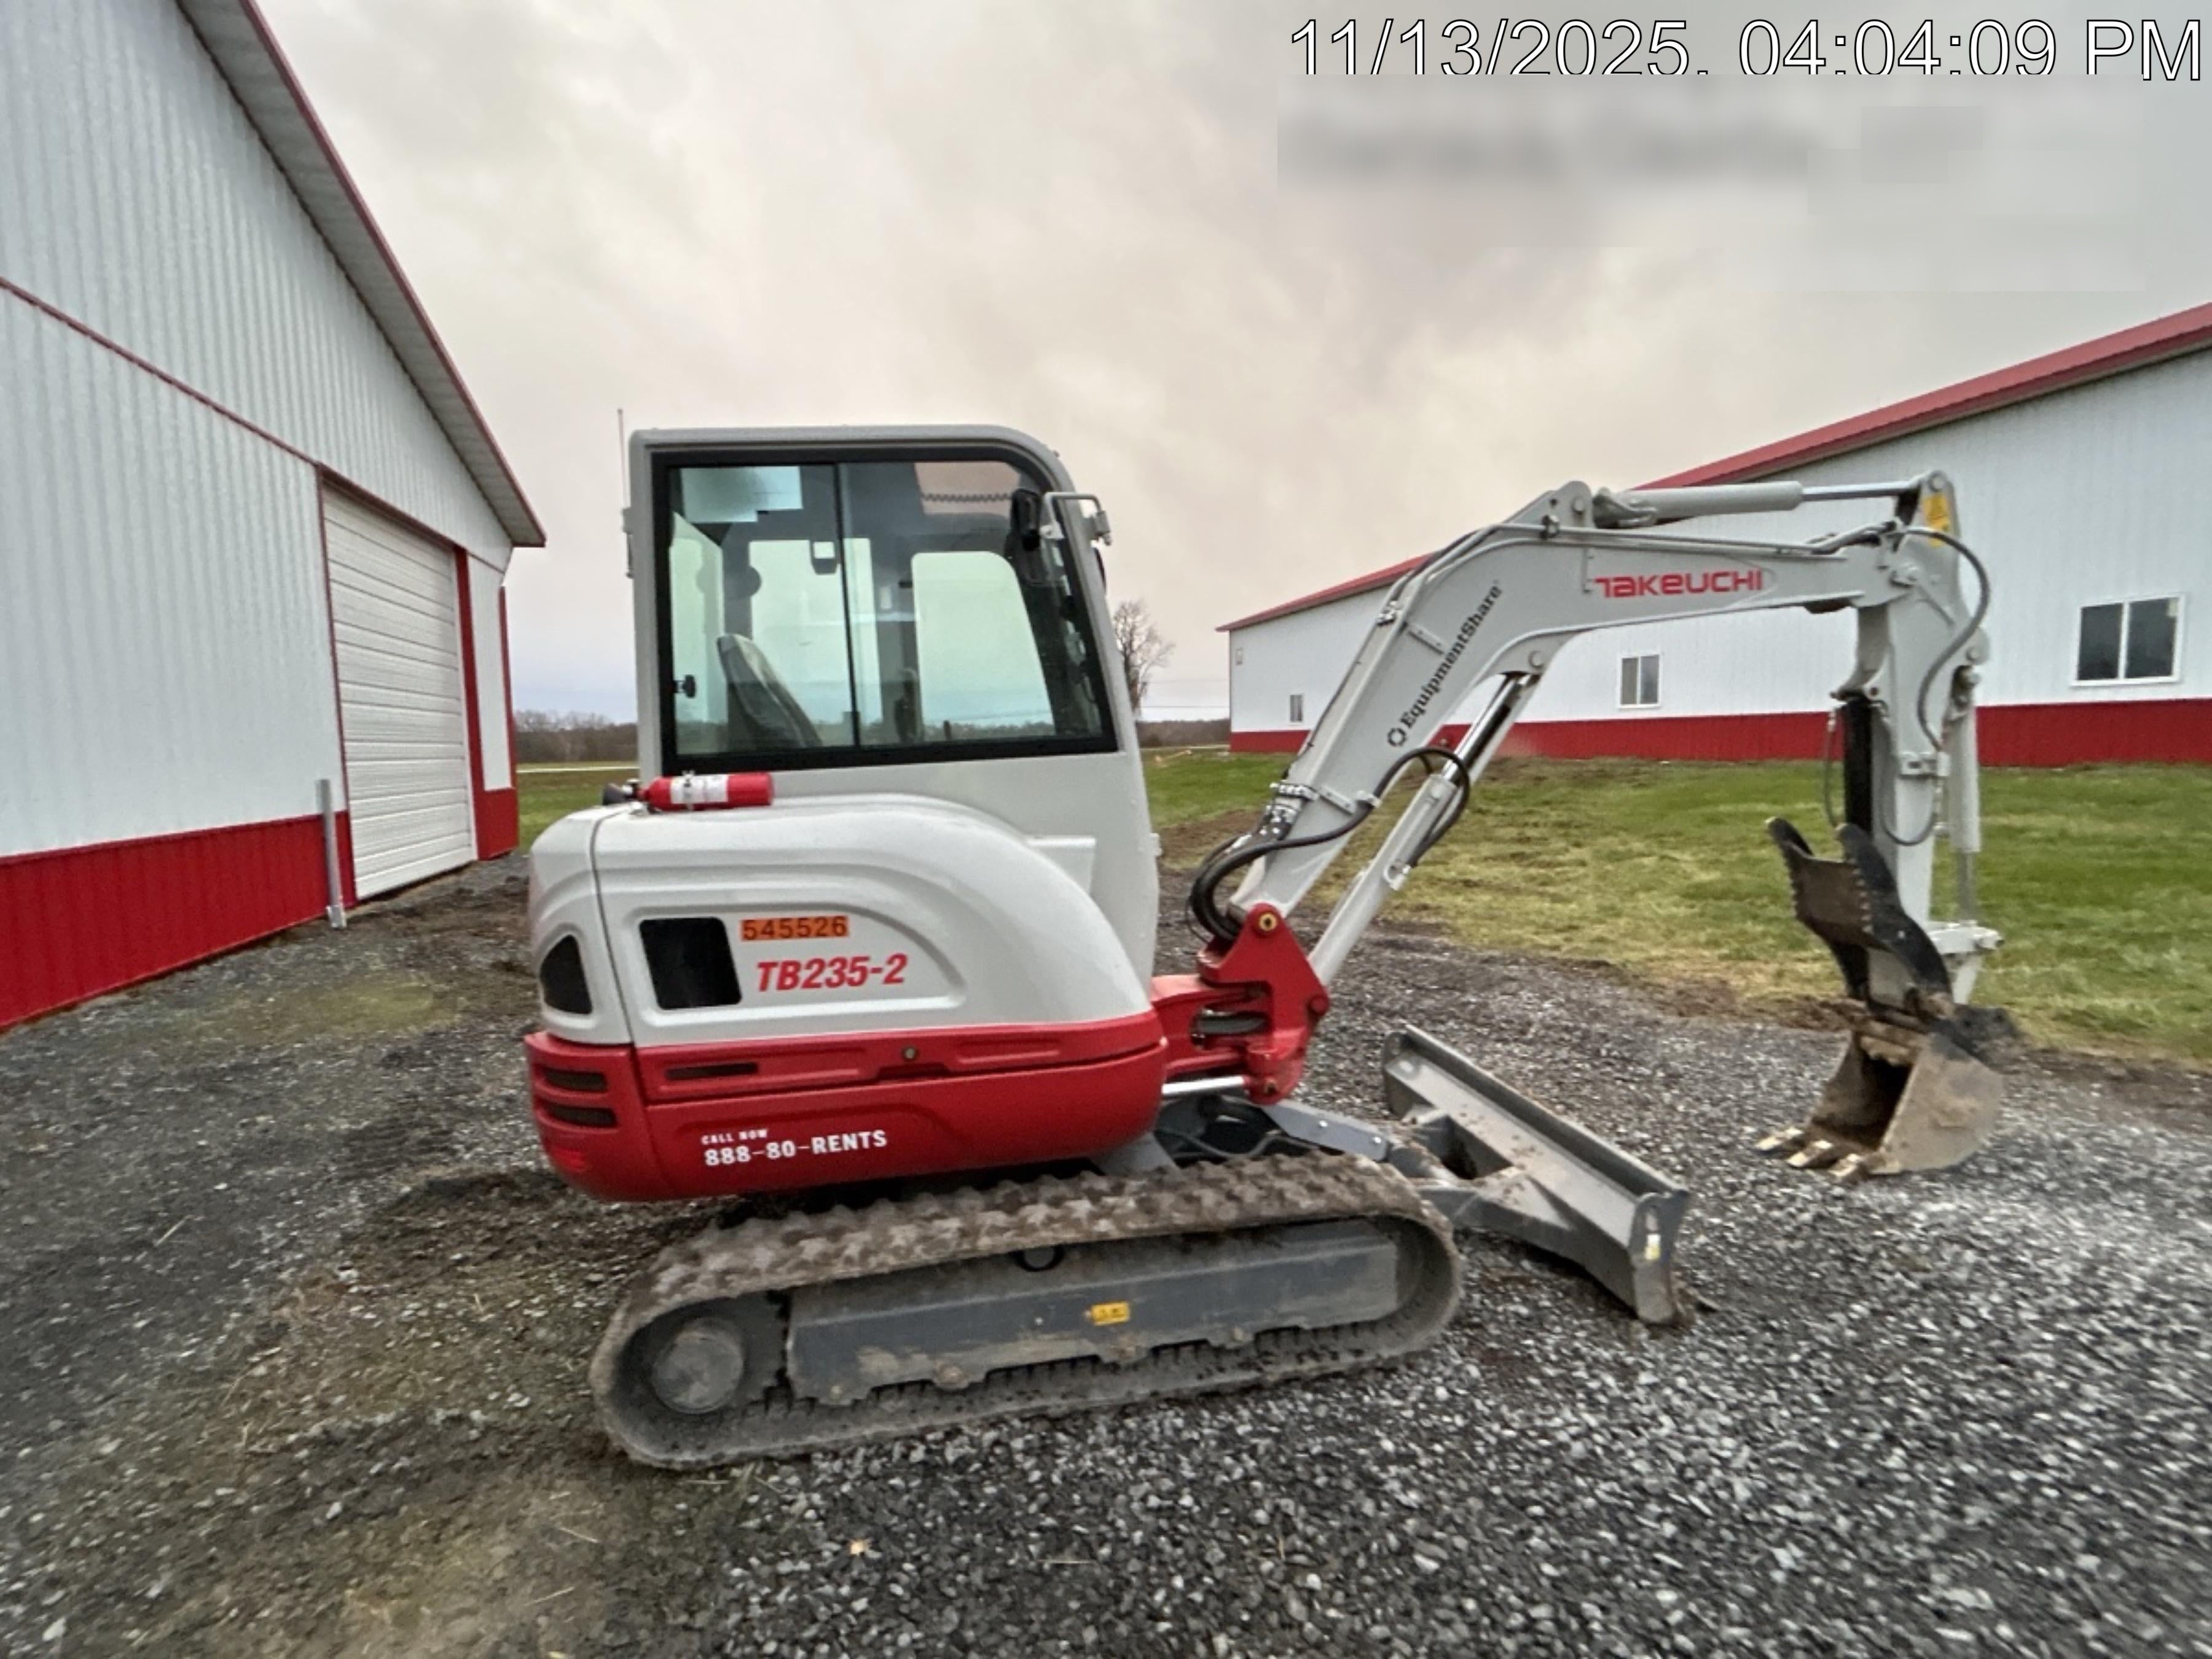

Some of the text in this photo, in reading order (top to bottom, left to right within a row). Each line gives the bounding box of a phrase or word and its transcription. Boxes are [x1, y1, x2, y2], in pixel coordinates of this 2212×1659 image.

[1402, 586, 1502, 729] EquipmentShare
[743, 917, 847, 939] 545526
[757, 954, 908, 992] TB235-2
[702, 1129, 769, 1145] CALL NOW
[705, 1131, 887, 1166] 888-80-RENTS
